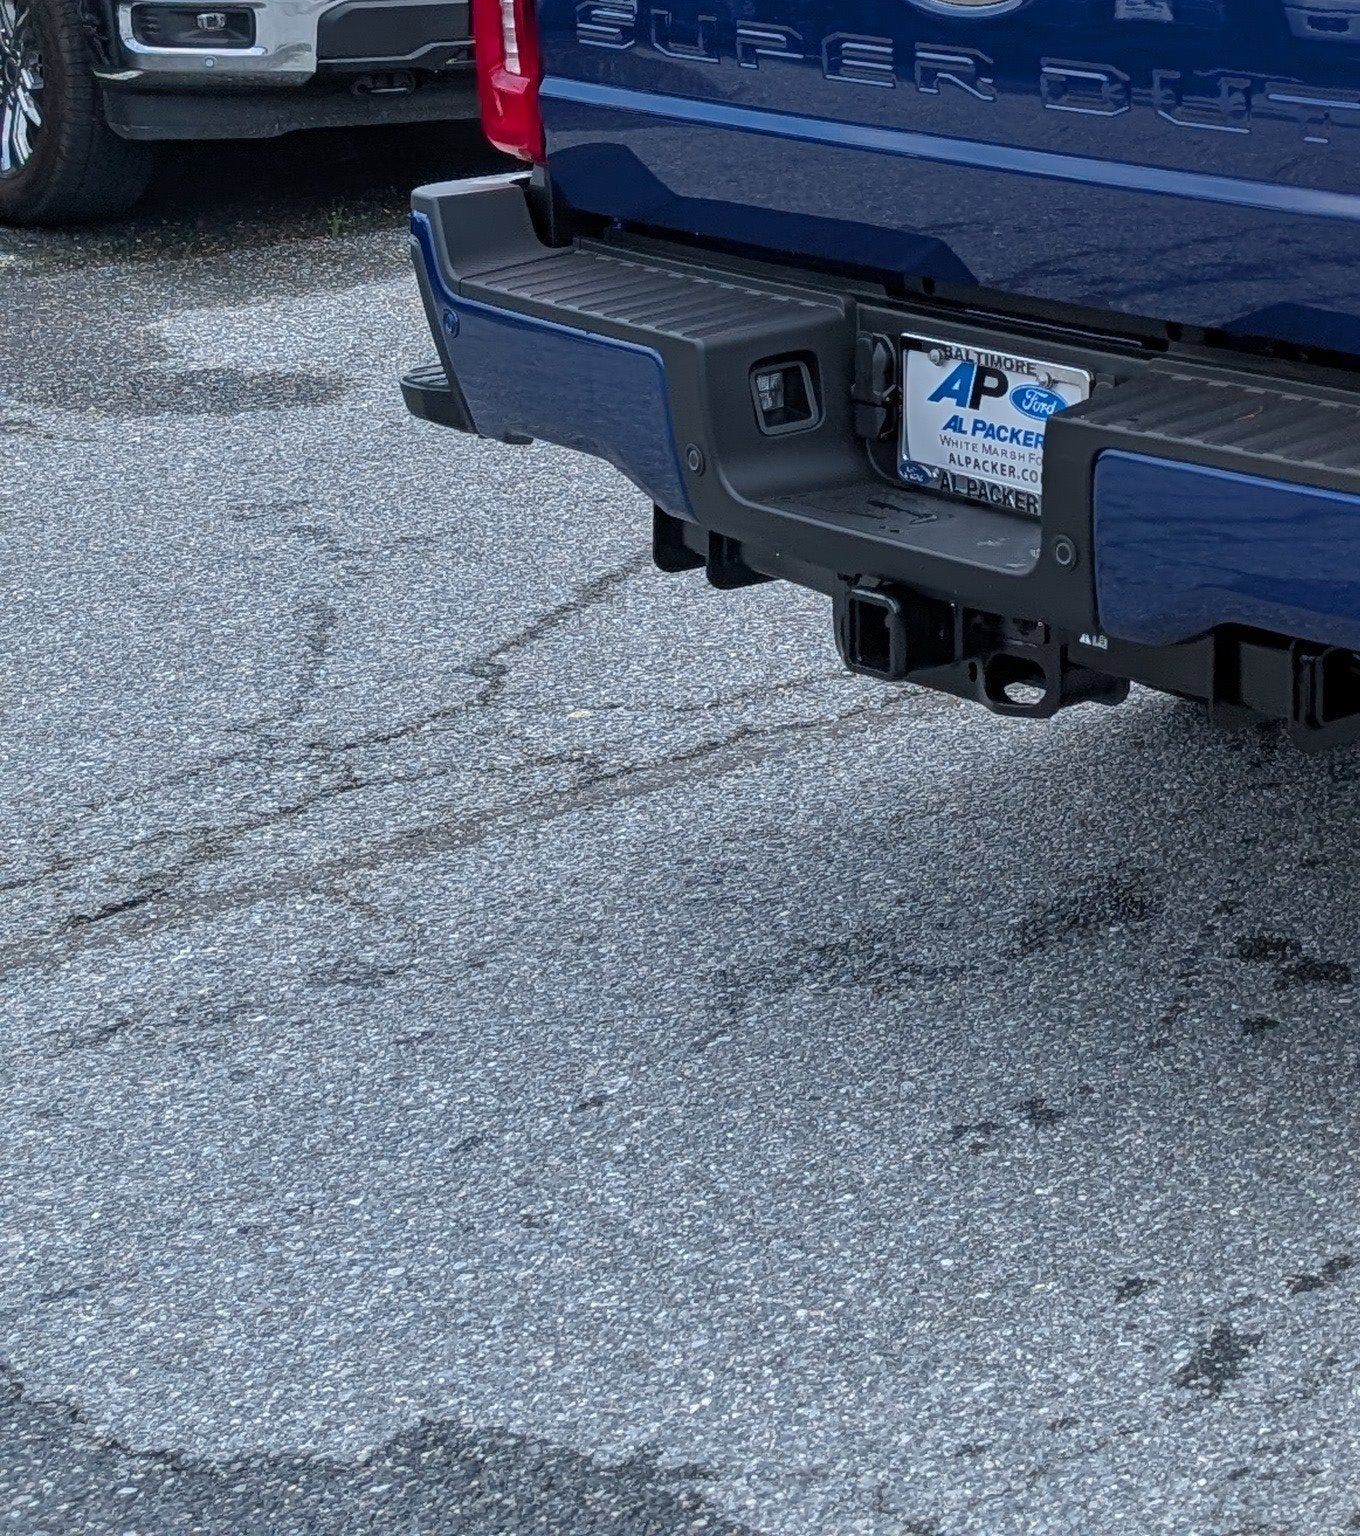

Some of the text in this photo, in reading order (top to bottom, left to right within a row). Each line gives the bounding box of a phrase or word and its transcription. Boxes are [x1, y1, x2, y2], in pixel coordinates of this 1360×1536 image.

[944, 347, 1037, 377] BALTIMORE
[927, 361, 1010, 411] AP
[1022, 388, 1058, 415] Ford
[939, 434, 979, 453] WHITE
[942, 414, 1045, 450] AL PACKER
[948, 452, 1040, 484] ALPACKER.CO
[940, 470, 1039, 515] AL PACKER
